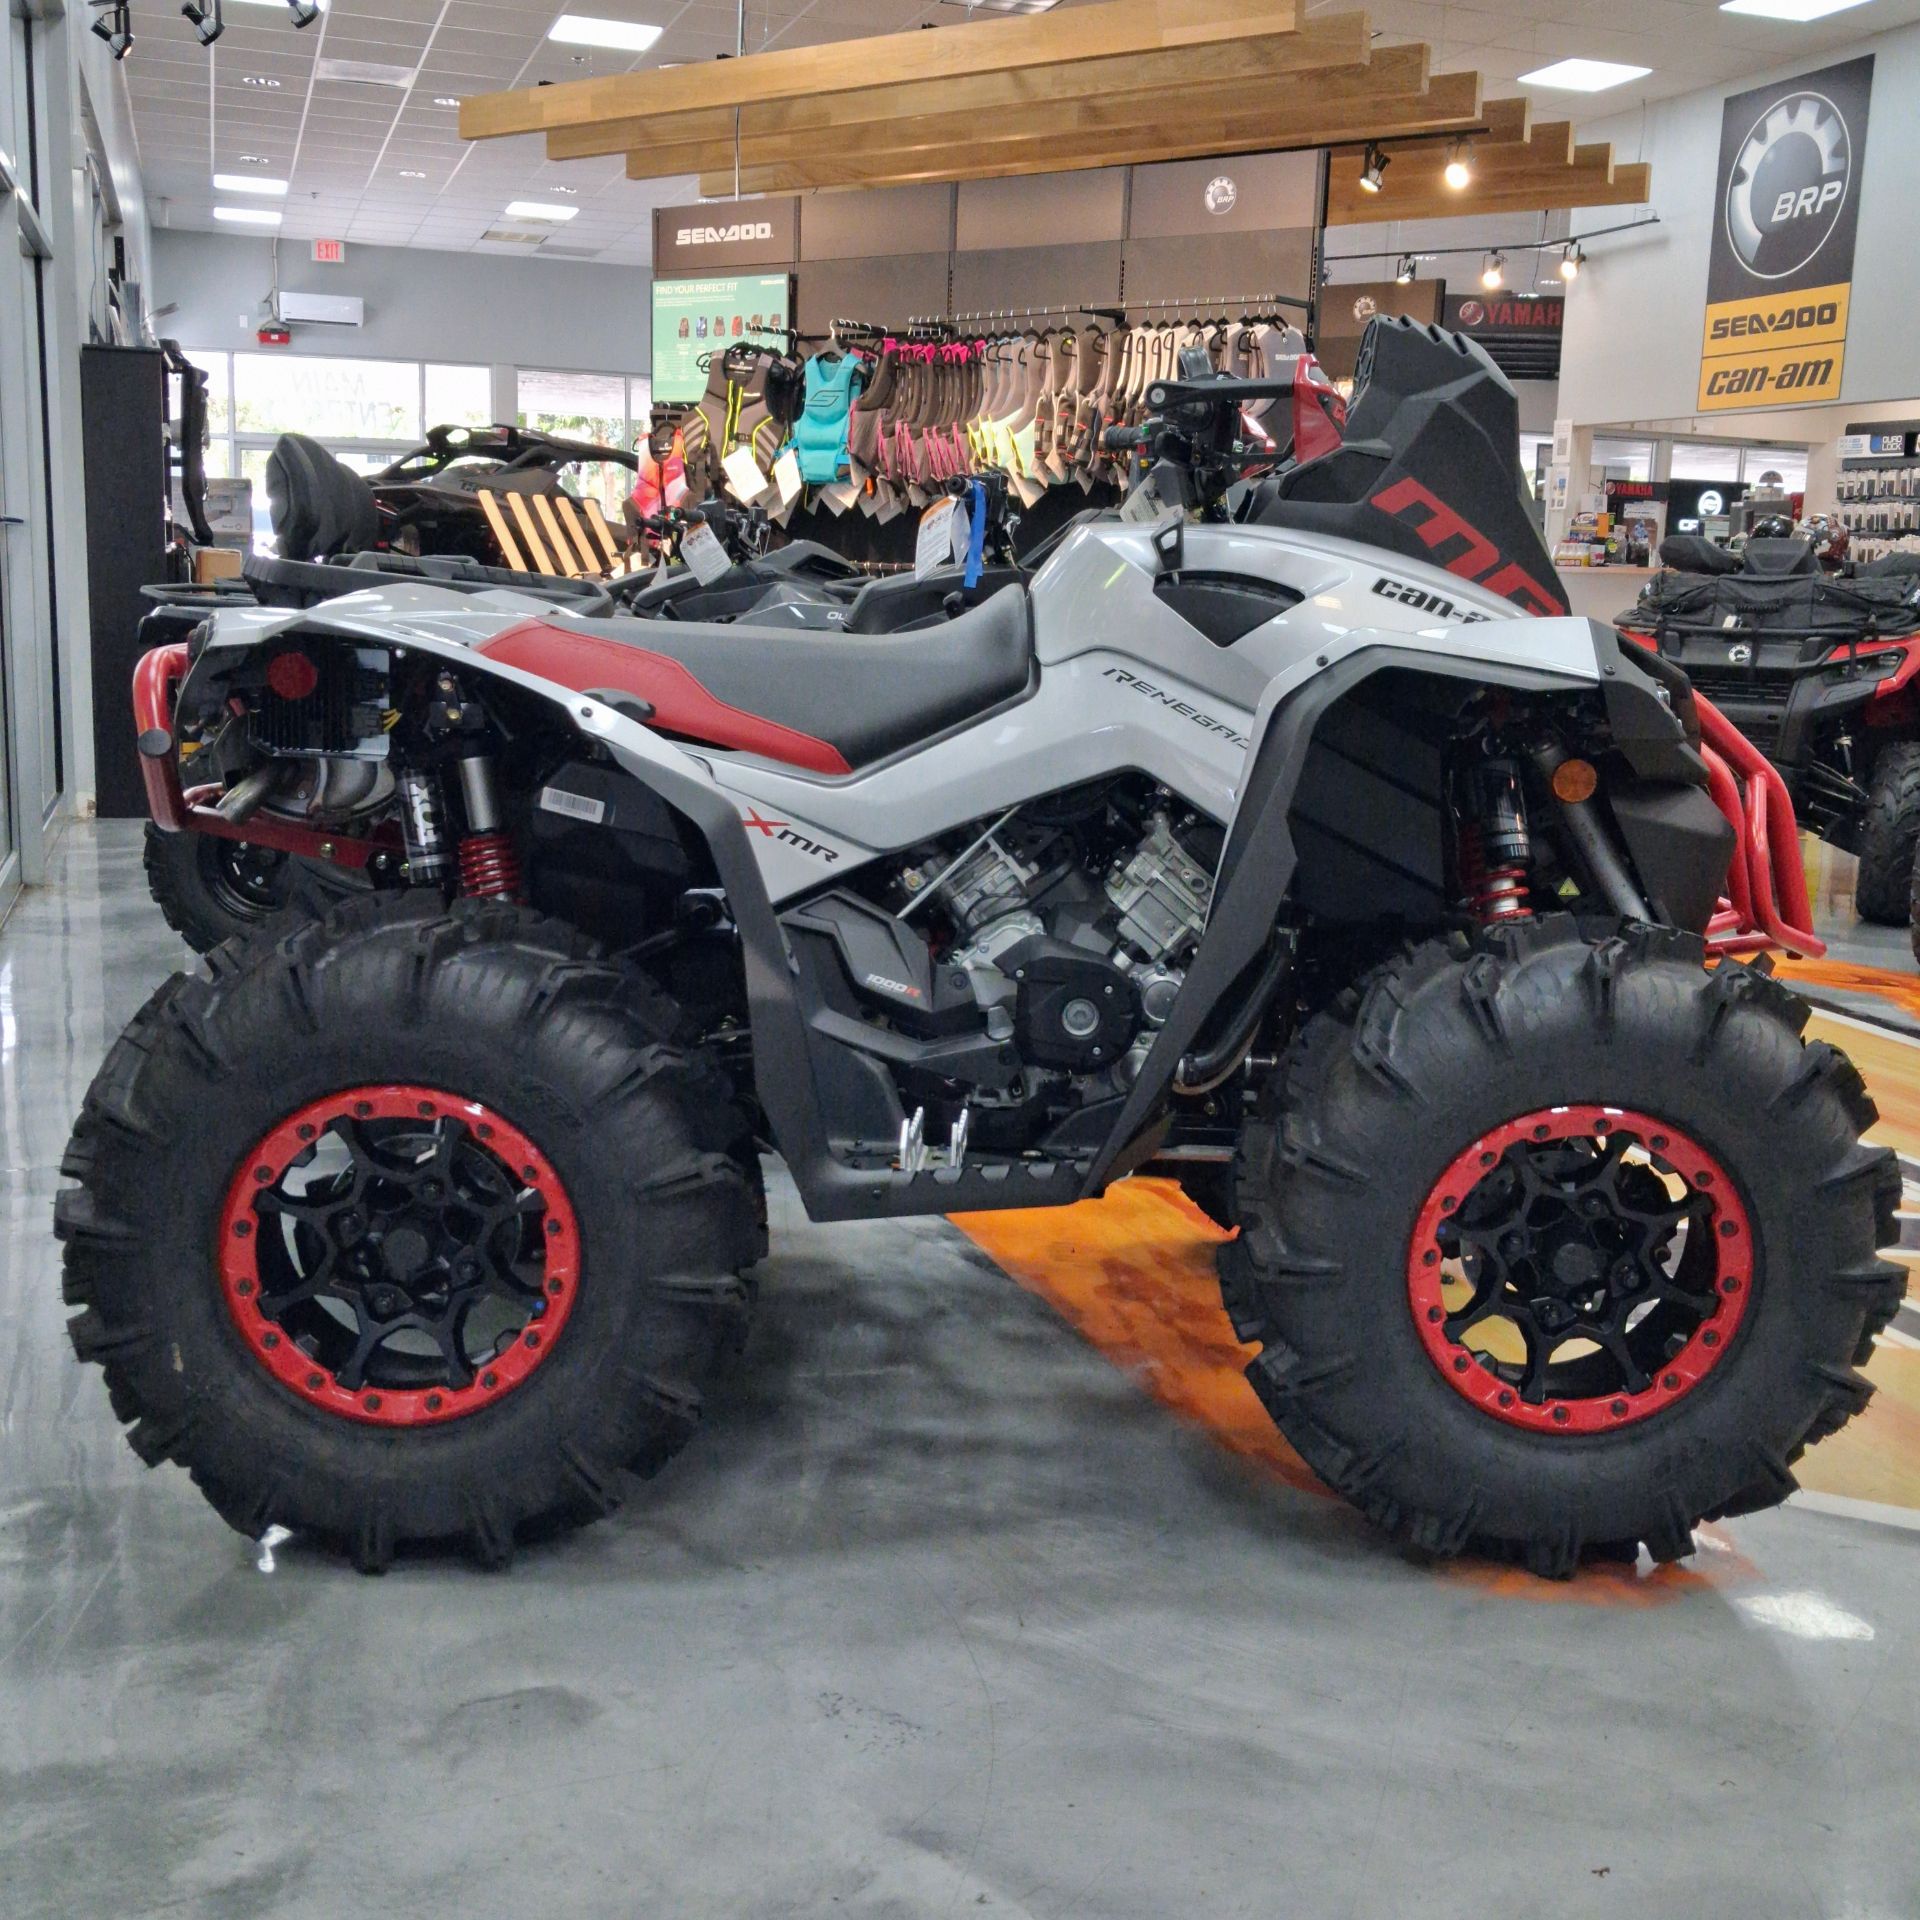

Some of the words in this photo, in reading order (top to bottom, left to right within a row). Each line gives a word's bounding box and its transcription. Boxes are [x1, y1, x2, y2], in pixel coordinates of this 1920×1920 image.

[1771, 180, 1842, 223] BRP
[317, 242, 340, 260] EXIT
[655, 286, 673, 294] FIND
[674, 284, 694, 294] YOUR
[695, 282, 726, 293] PERFECT
[727, 281, 738, 291] FIT
[1706, 358, 1835, 396] can-am
[1881, 442, 1903, 451] LOCK
[1616, 482, 1653, 496] YAMAHA
[865, 973, 922, 997] 1000R
